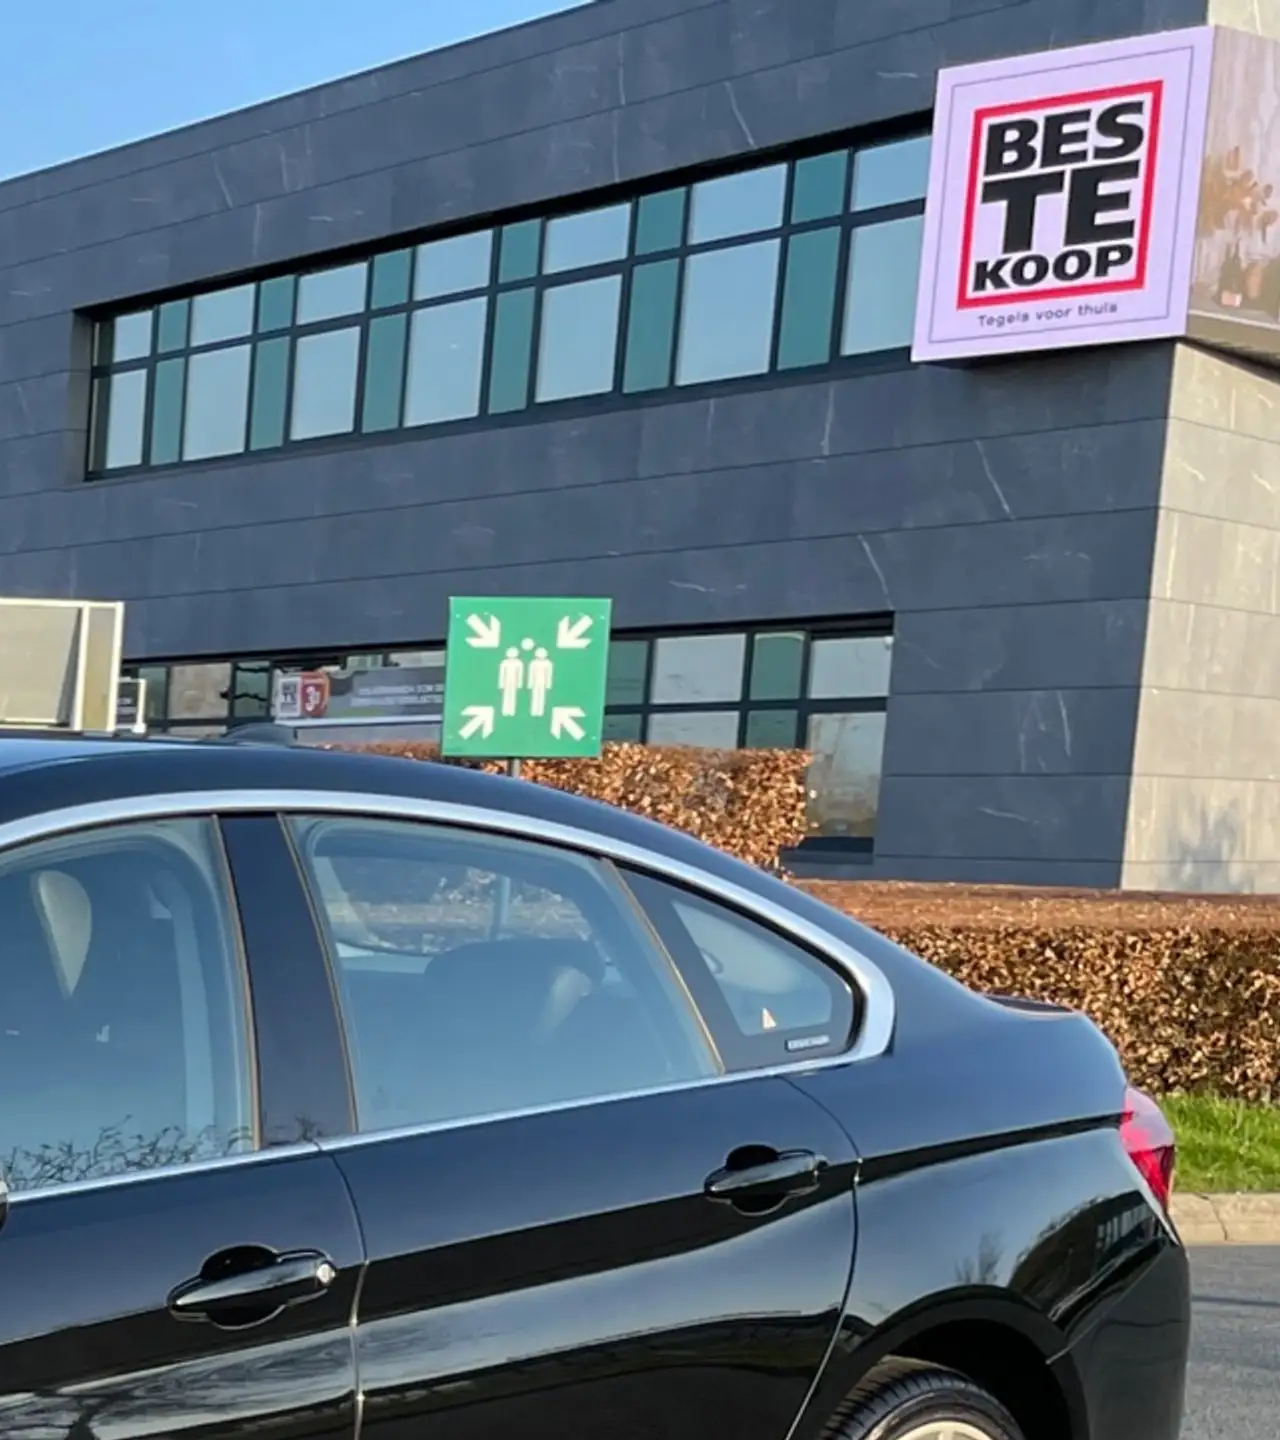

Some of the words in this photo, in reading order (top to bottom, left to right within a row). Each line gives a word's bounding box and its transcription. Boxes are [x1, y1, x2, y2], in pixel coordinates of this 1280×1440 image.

[984, 100, 1144, 176] BES
[981, 160, 1140, 254] TE
[972, 244, 1134, 292] KOOP
[977, 311, 1030, 328] Tegels
[1036, 306, 1072, 321] voor
[1078, 302, 1118, 317] thuis
